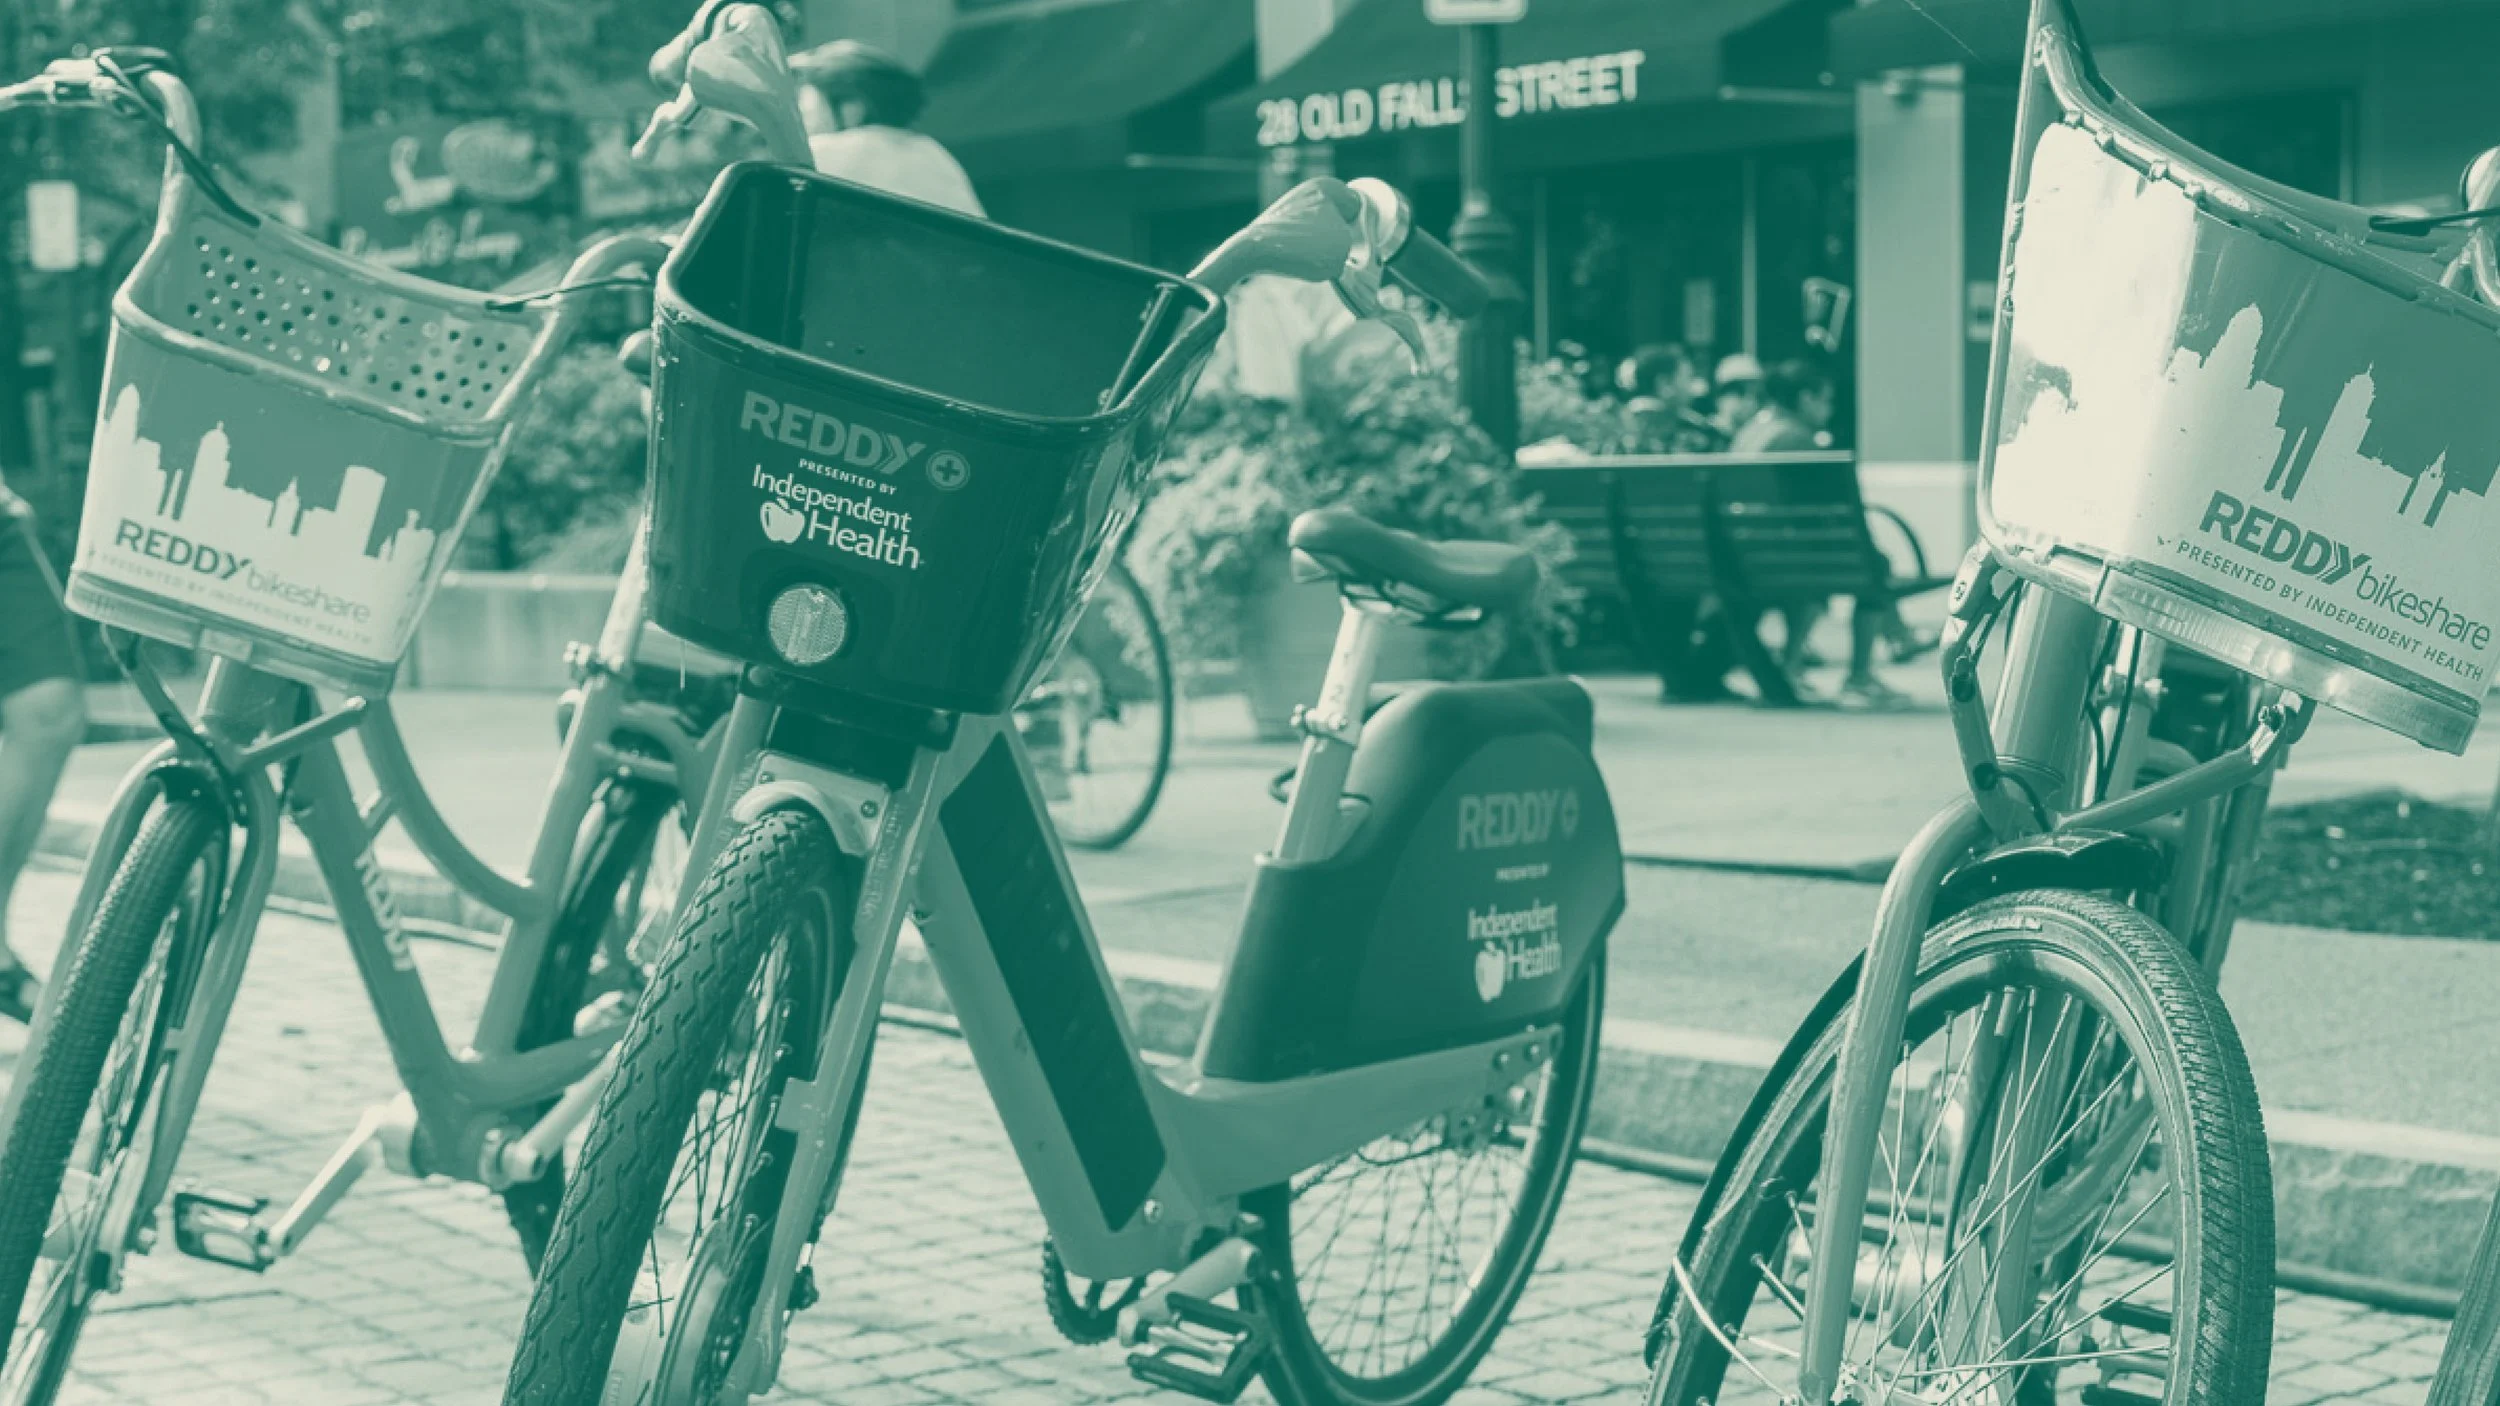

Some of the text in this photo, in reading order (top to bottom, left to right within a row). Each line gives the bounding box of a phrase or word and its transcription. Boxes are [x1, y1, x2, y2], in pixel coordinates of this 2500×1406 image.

[1300, 88, 1373, 140] OLD
[1495, 49, 1645, 118] STREET
[740, 391, 926, 475] REDDY
[752, 464, 912, 533] Independent
[799, 458, 897, 495] PRESENTED BY
[114, 518, 371, 624] REDDY bikeshare
[808, 509, 920, 570] Health
[2199, 490, 2491, 651] REDDY bikeshare
[2177, 540, 2484, 682] PRESENTED BY INDEPENDENT HEALTH
[1458, 788, 1559, 851] REDDY
